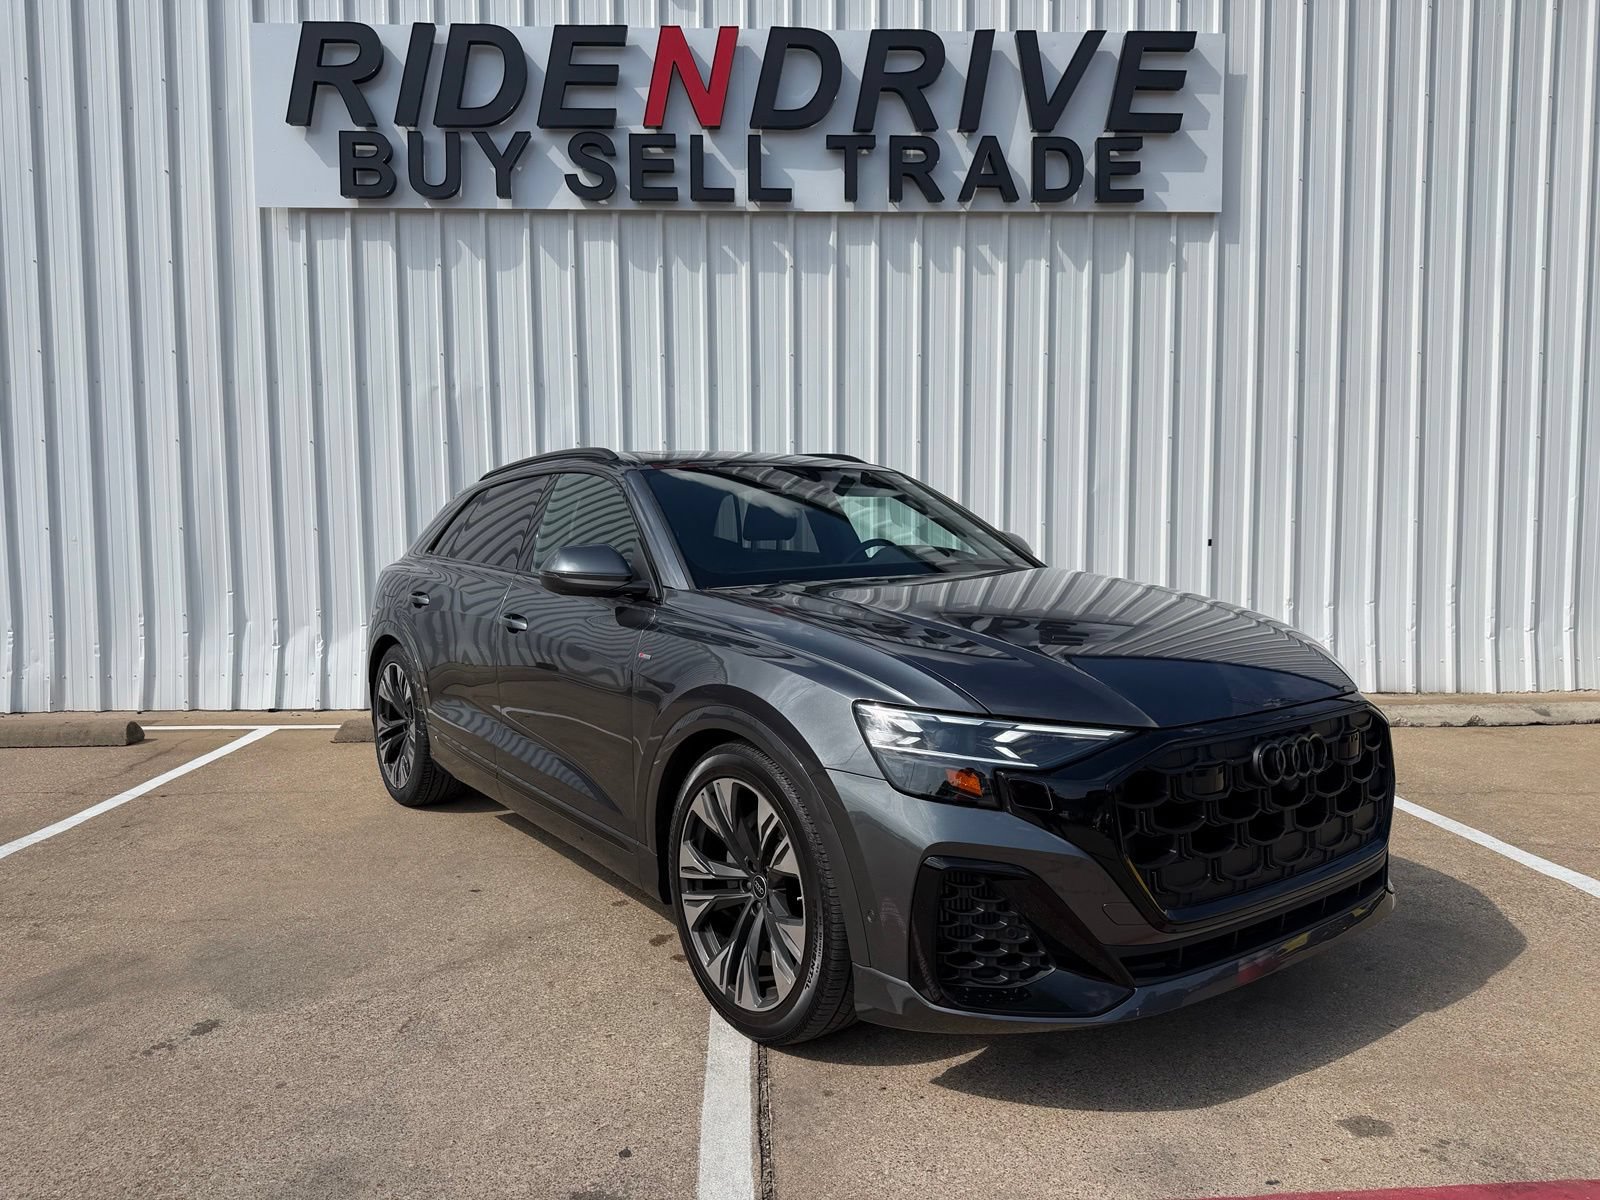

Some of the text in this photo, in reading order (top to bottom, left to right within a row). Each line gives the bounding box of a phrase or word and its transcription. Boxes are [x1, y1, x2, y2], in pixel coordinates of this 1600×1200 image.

[285, 21, 1197, 133] RIDENDRIVE
[338, 131, 1144, 203] BUY SELL TRADE
